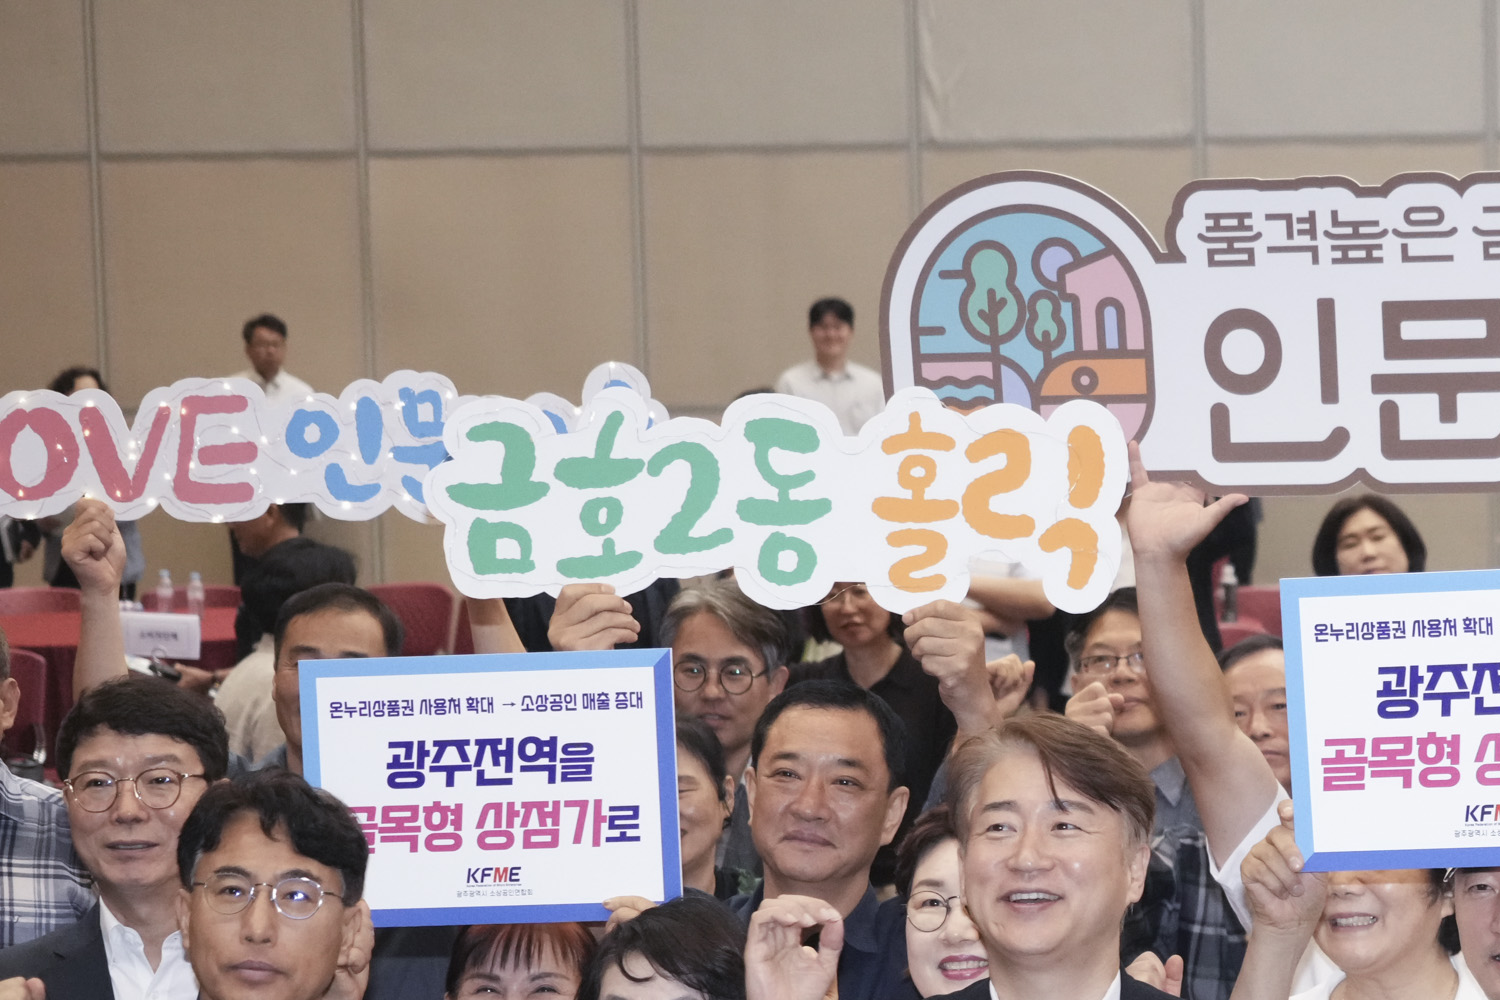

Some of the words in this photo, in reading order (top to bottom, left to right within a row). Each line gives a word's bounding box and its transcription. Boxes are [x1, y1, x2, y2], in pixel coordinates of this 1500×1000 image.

[1197, 206, 1458, 267] 품격높은
[445, 410, 833, 587] 금호2동
[870, 410, 1106, 594] 홀릭
[1315, 621, 1406, 642] 온누리상품권
[1412, 618, 1457, 638] 사용처
[1463, 617, 1493, 635] 확대
[330, 700, 414, 718] 온누리상품권
[420, 698, 460, 715] 사용처
[466, 697, 493, 714] 확대
[521, 694, 577, 712] 소상공인
[582, 693, 610, 710] 매출
[615, 692, 642, 709] 증대
[387, 736, 594, 789] 광주전역을
[1321, 732, 1460, 791] 골목형
[476, 799, 640, 850] 상점가로
[467, 867, 521, 883] KFME
